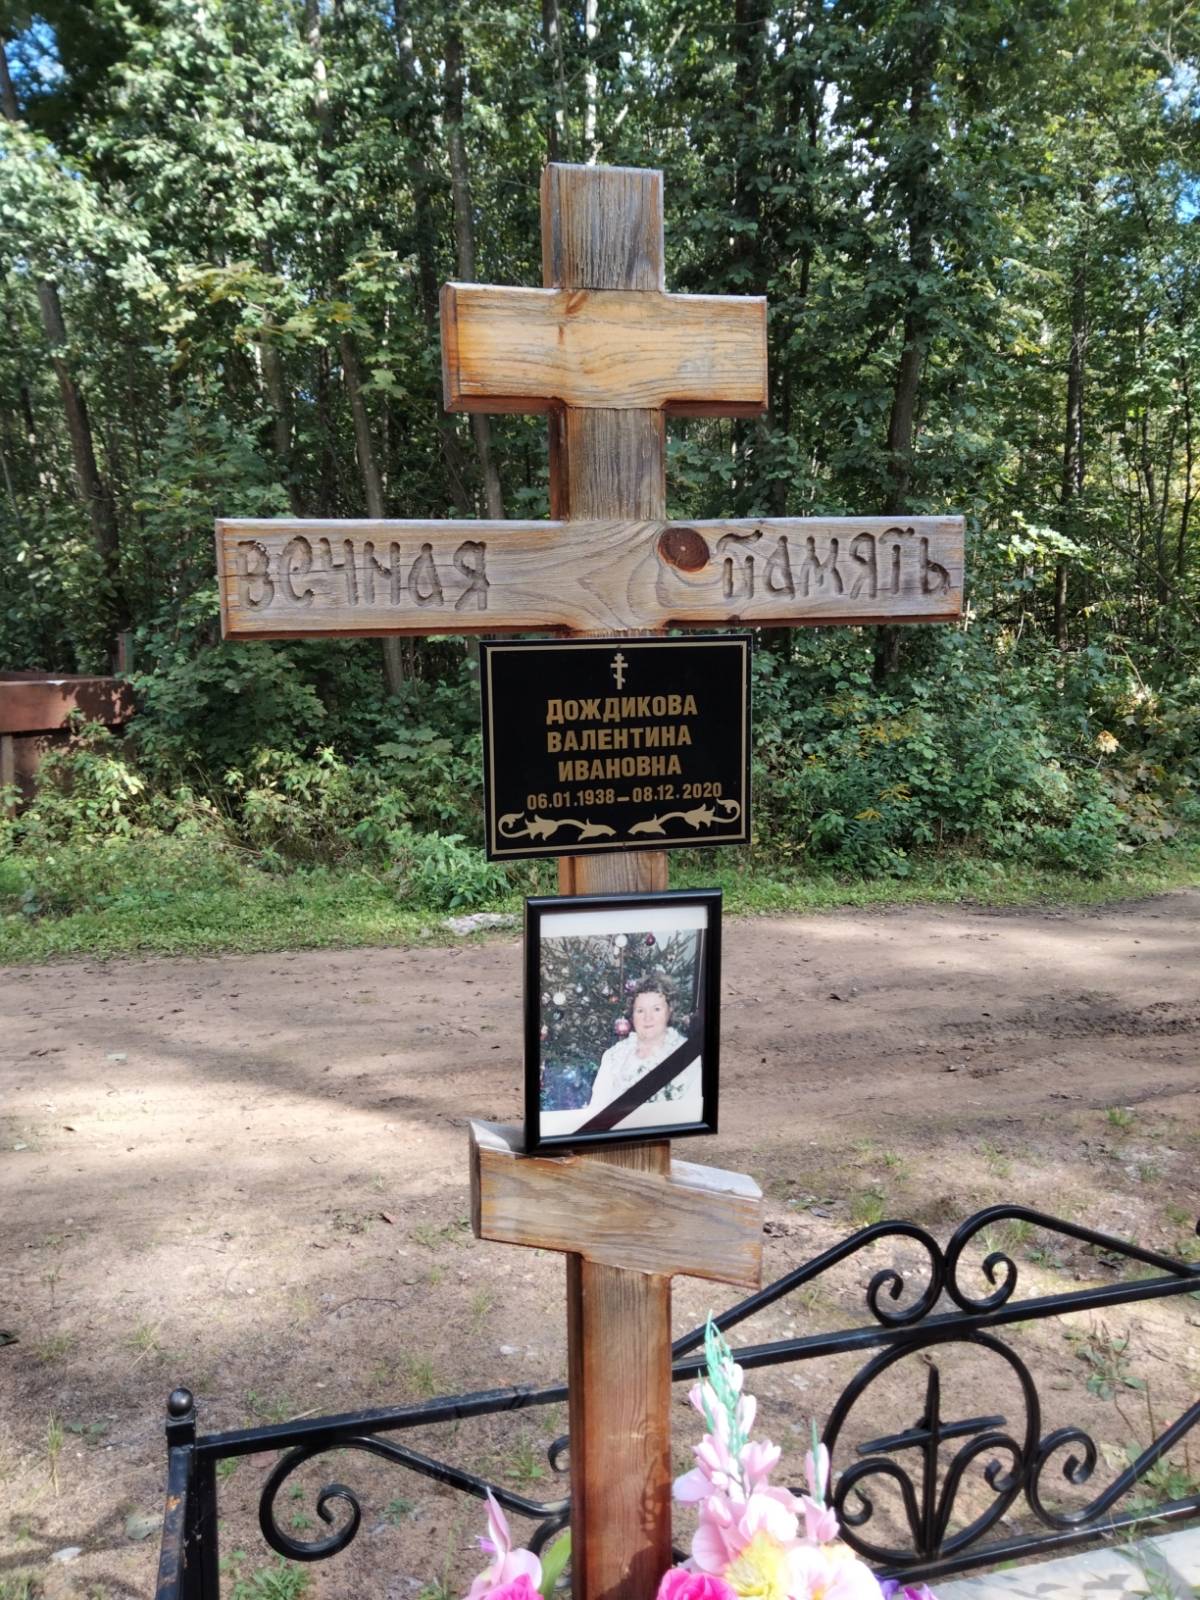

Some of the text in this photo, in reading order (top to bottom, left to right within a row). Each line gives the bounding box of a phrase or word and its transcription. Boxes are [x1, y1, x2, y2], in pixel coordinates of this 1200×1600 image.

[236, 527, 950, 611] ВЕЧНАЯ ПАМЯТЬ
[546, 694, 698, 725] ДОЖДИКОВА
[547, 724, 692, 753] ВАЛЕНТИНА
[558, 754, 682, 782] ИВАНОВНА
